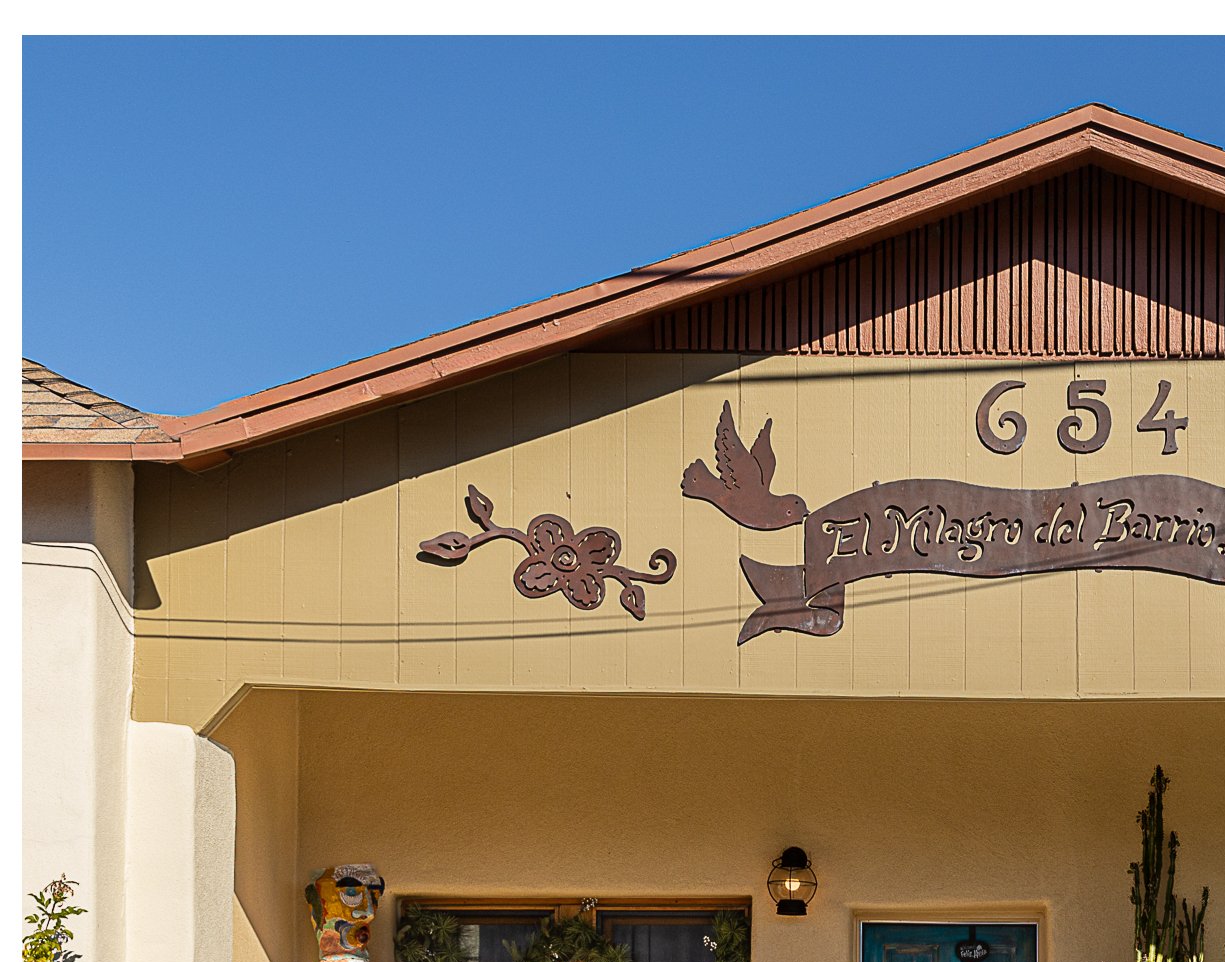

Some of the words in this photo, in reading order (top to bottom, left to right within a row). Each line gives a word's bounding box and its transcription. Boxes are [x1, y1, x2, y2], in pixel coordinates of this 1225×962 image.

[976, 380, 1188, 455] 654
[821, 513, 872, 564] El
[881, 504, 1023, 562] Milagro
[1034, 502, 1087, 546] del
[1093, 498, 1215, 551] Barrio
